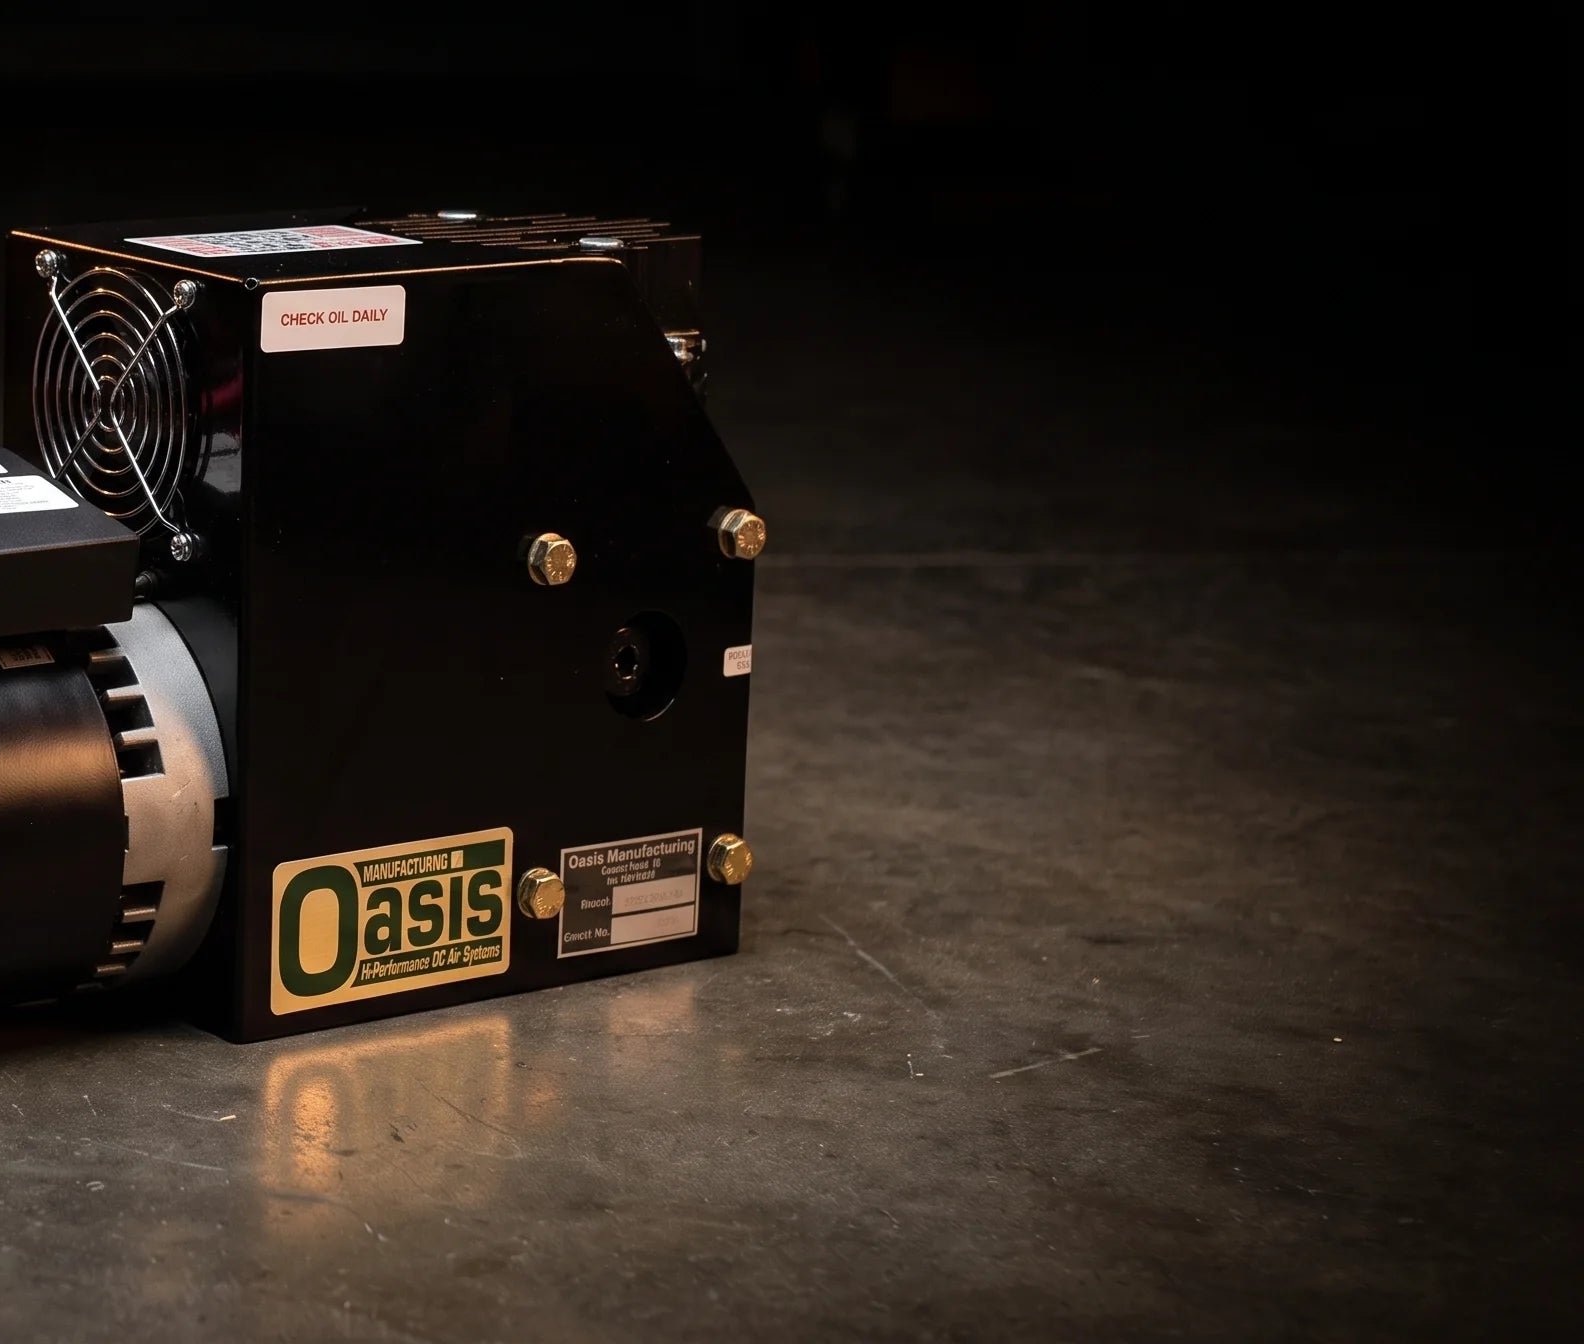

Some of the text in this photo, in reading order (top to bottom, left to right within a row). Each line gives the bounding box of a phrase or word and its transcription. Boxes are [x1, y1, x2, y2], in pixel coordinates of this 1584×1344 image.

[281, 308, 388, 327] CHECK OIL DAILY
[568, 839, 695, 870] Oasis Manufacturing
[278, 850, 503, 998] Oasis
[432, 950, 446, 969] DC
[447, 947, 459, 966] Air
